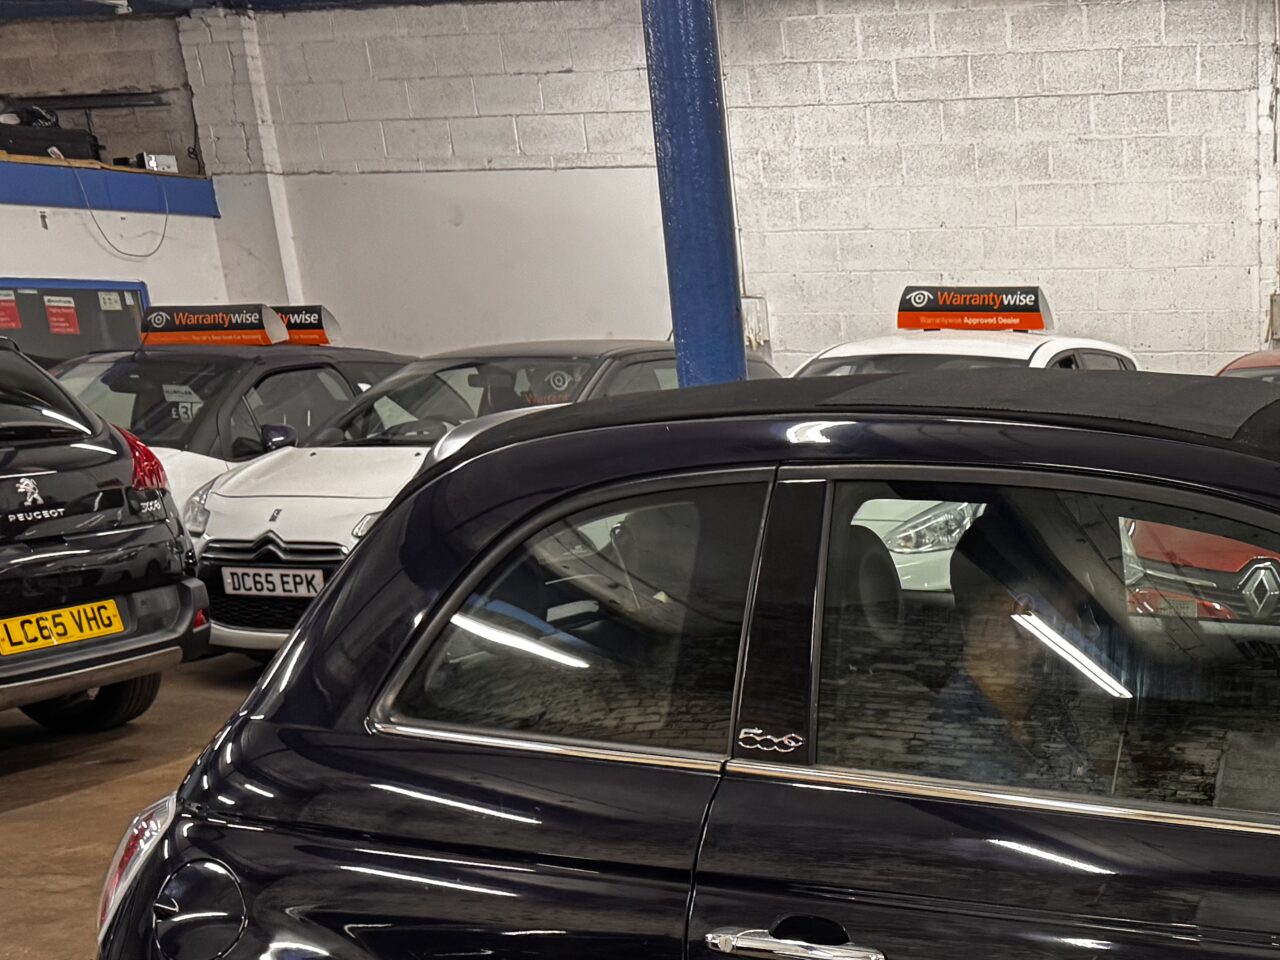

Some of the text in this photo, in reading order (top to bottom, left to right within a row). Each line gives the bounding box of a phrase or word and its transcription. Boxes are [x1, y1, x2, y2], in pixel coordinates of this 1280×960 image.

[937, 291, 1035, 309] Warrantywise
[174, 310, 260, 328] Warrantywise
[8, 508, 65, 523] PEUGEOT
[230, 571, 319, 594] DC65 EPK
[3, 604, 113, 647] LC65 VHG
